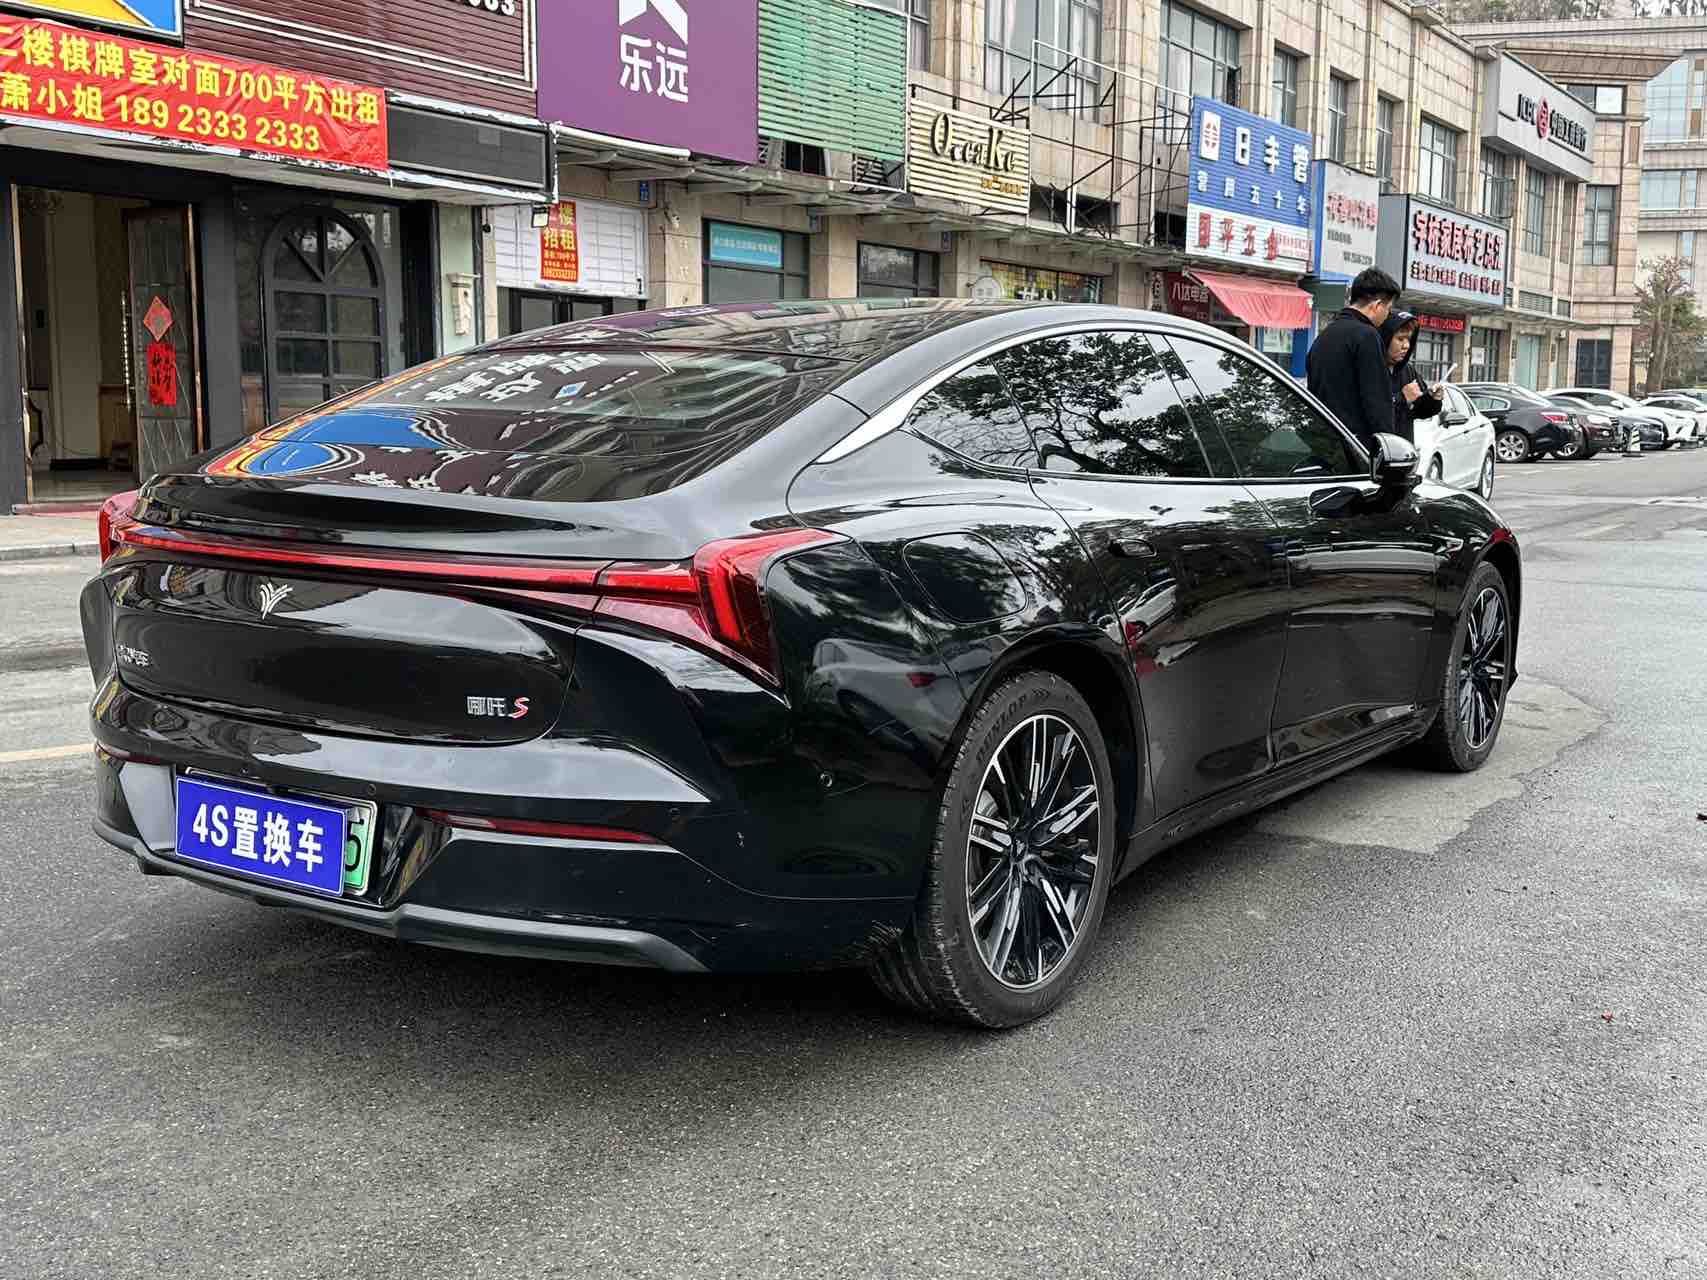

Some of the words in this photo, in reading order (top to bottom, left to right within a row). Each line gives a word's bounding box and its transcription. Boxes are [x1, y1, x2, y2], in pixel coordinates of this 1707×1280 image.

[0, 25, 380, 125] 二楼棋牌室对面700平方出租
[618, 34, 689, 103] 乐远
[0, 72, 104, 122] 萧小姐
[115, 94, 169, 129] 189
[177, 103, 248, 142] 2333
[255, 114, 321, 152] 2333
[1235, 126, 1309, 184] 日丰管
[543, 228, 576, 250] 招租
[466, 695, 506, 717] 哪吒
[508, 696, 531, 720] S
[193, 803, 325, 874] 4S置换车
